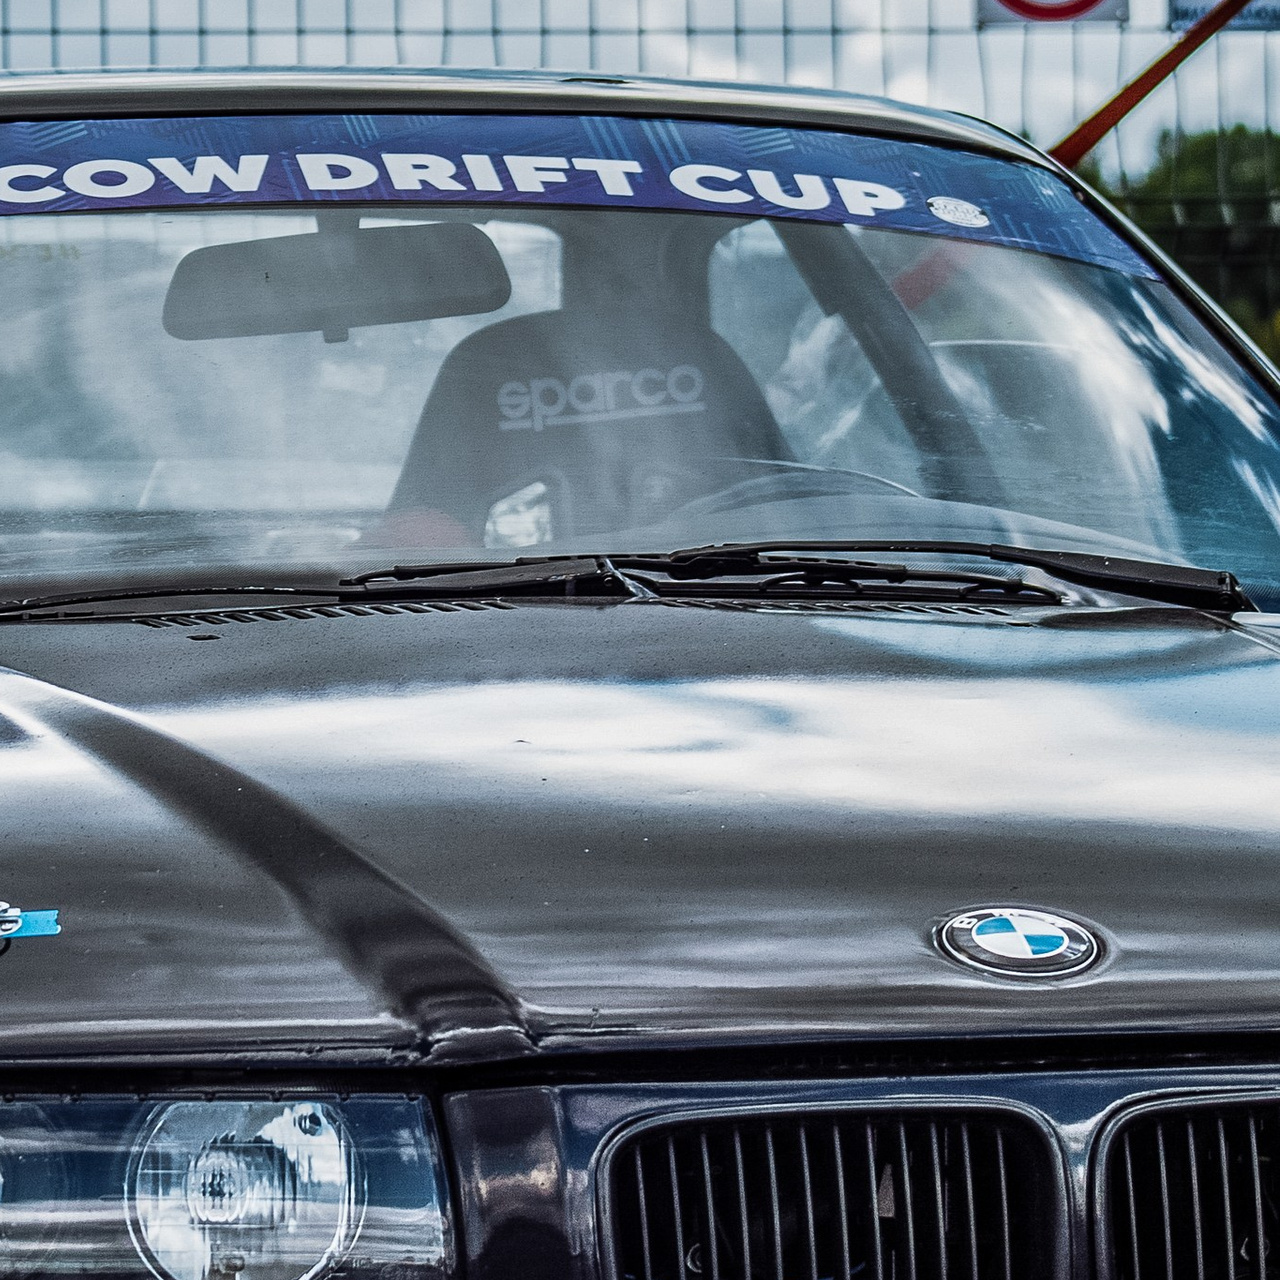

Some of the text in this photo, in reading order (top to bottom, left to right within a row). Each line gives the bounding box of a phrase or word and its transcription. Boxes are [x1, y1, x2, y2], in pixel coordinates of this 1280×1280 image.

[296, 152, 645, 197] DRIFT
[668, 164, 906, 218] CUP
[497, 365, 704, 432] sparco
